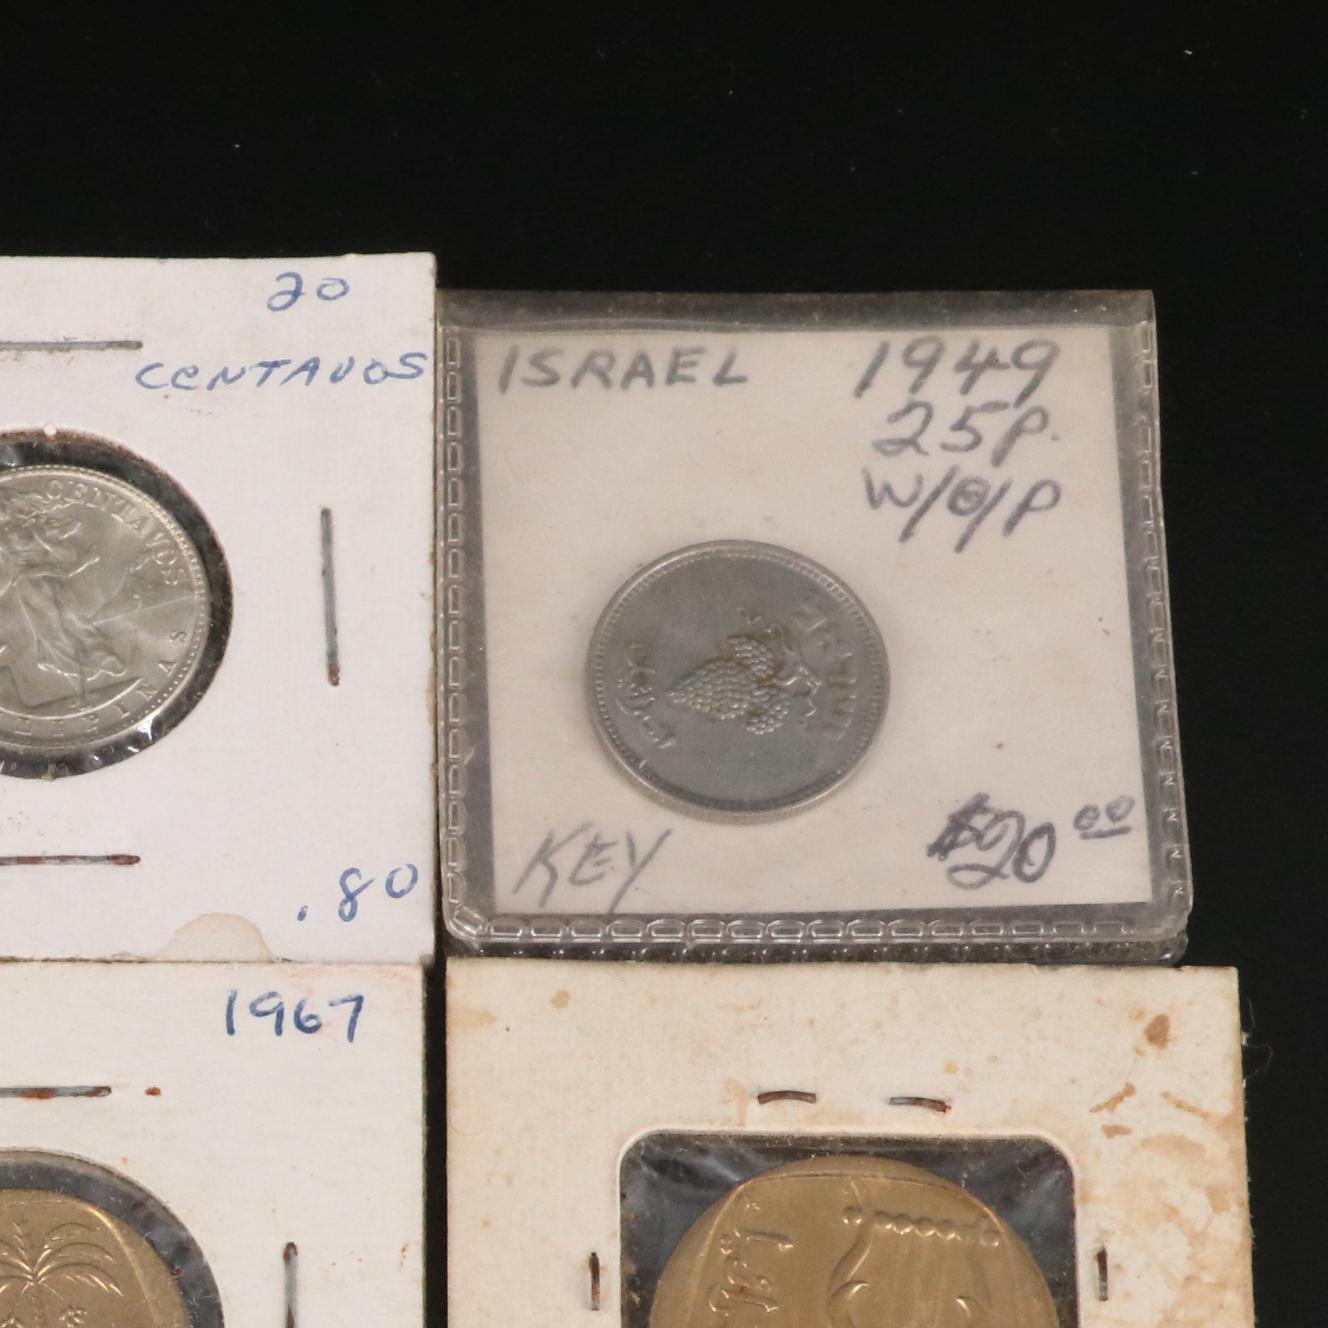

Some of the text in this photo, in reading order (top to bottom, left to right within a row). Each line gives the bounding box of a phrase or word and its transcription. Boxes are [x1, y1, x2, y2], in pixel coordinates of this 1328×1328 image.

[265, 271, 350, 311] 20
[497, 346, 750, 396] ISRAEL
[854, 336, 1061, 404] 1949
[513, 822, 673, 914] KEY
[225, 990, 366, 1043] 1967
